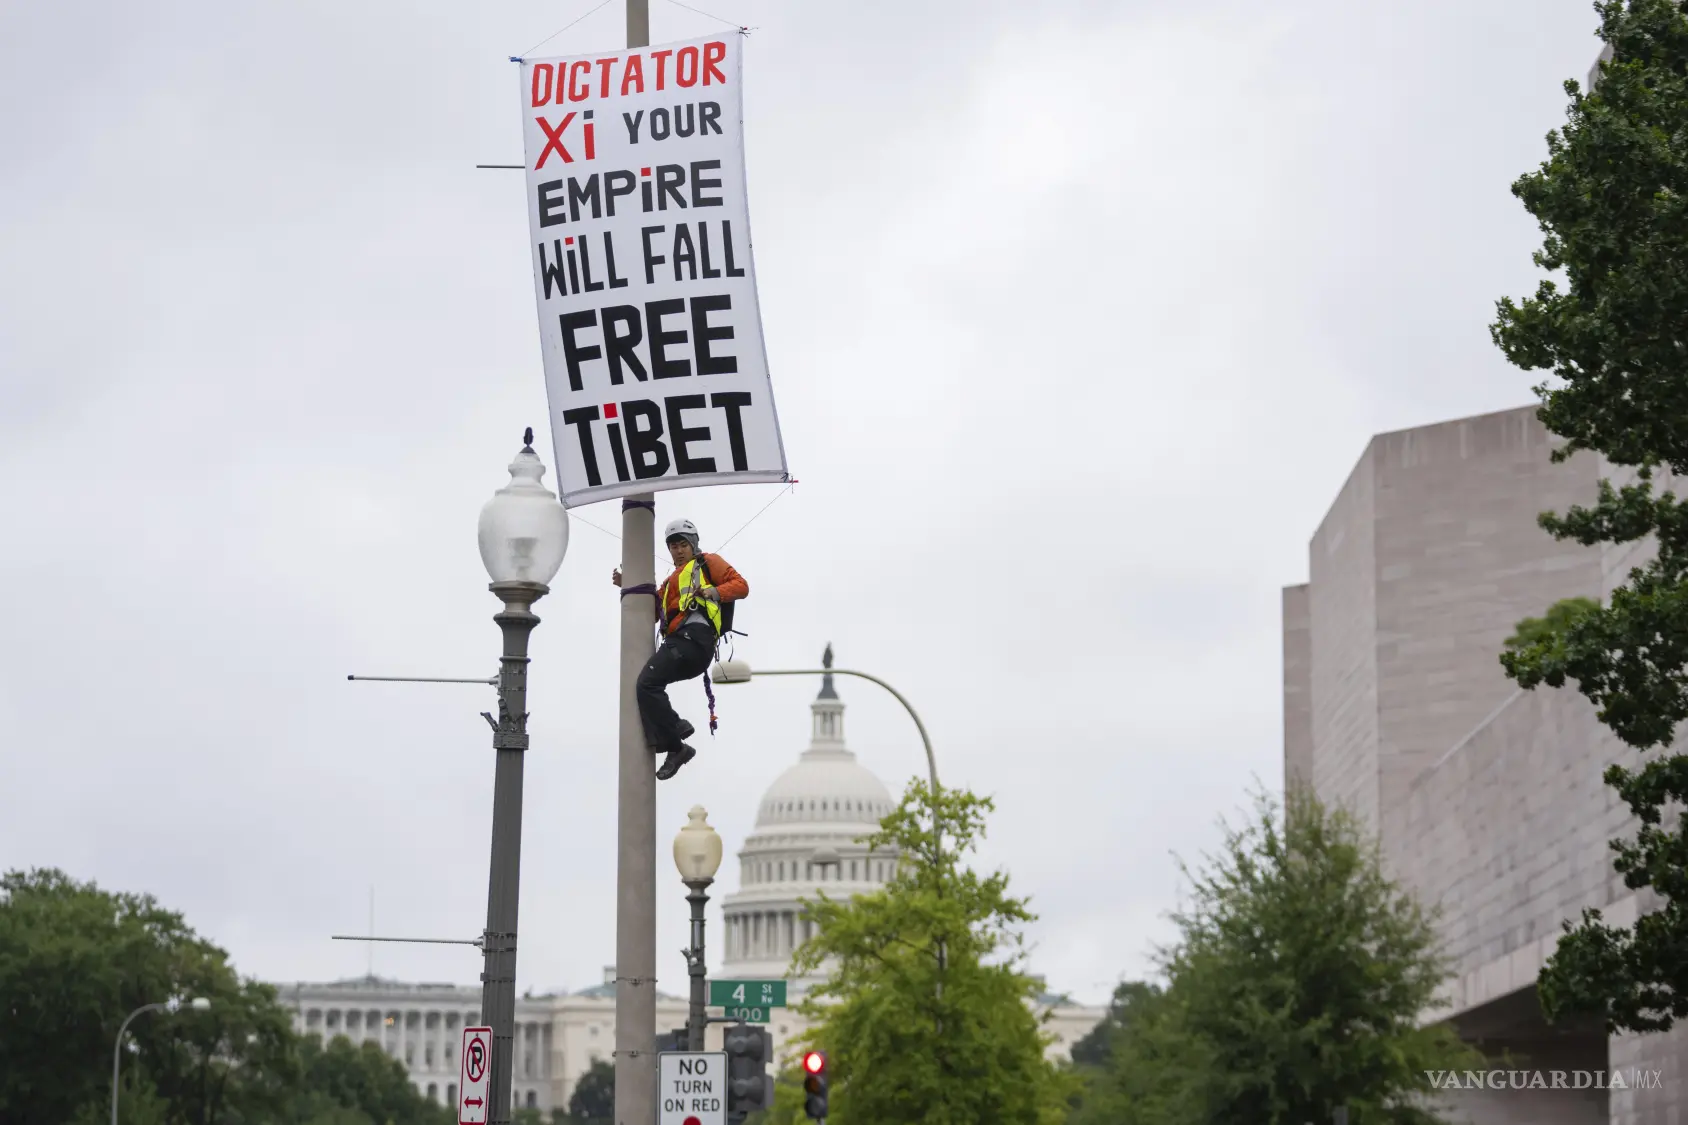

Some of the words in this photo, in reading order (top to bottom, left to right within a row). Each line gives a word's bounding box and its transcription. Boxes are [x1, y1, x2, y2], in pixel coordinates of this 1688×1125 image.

[531, 41, 726, 108] DICTATOR
[534, 110, 596, 170] Xi
[623, 101, 723, 145] YOUR
[641, 220, 745, 284] FALL
[559, 294, 738, 391] FREE
[732, 983, 746, 1004] 4
[732, 1007, 762, 1022] 100
[679, 1058, 708, 1075] NO
[673, 1080, 712, 1094] TURN
[665, 1098, 685, 1112] ON
[692, 1098, 720, 1112] RED
